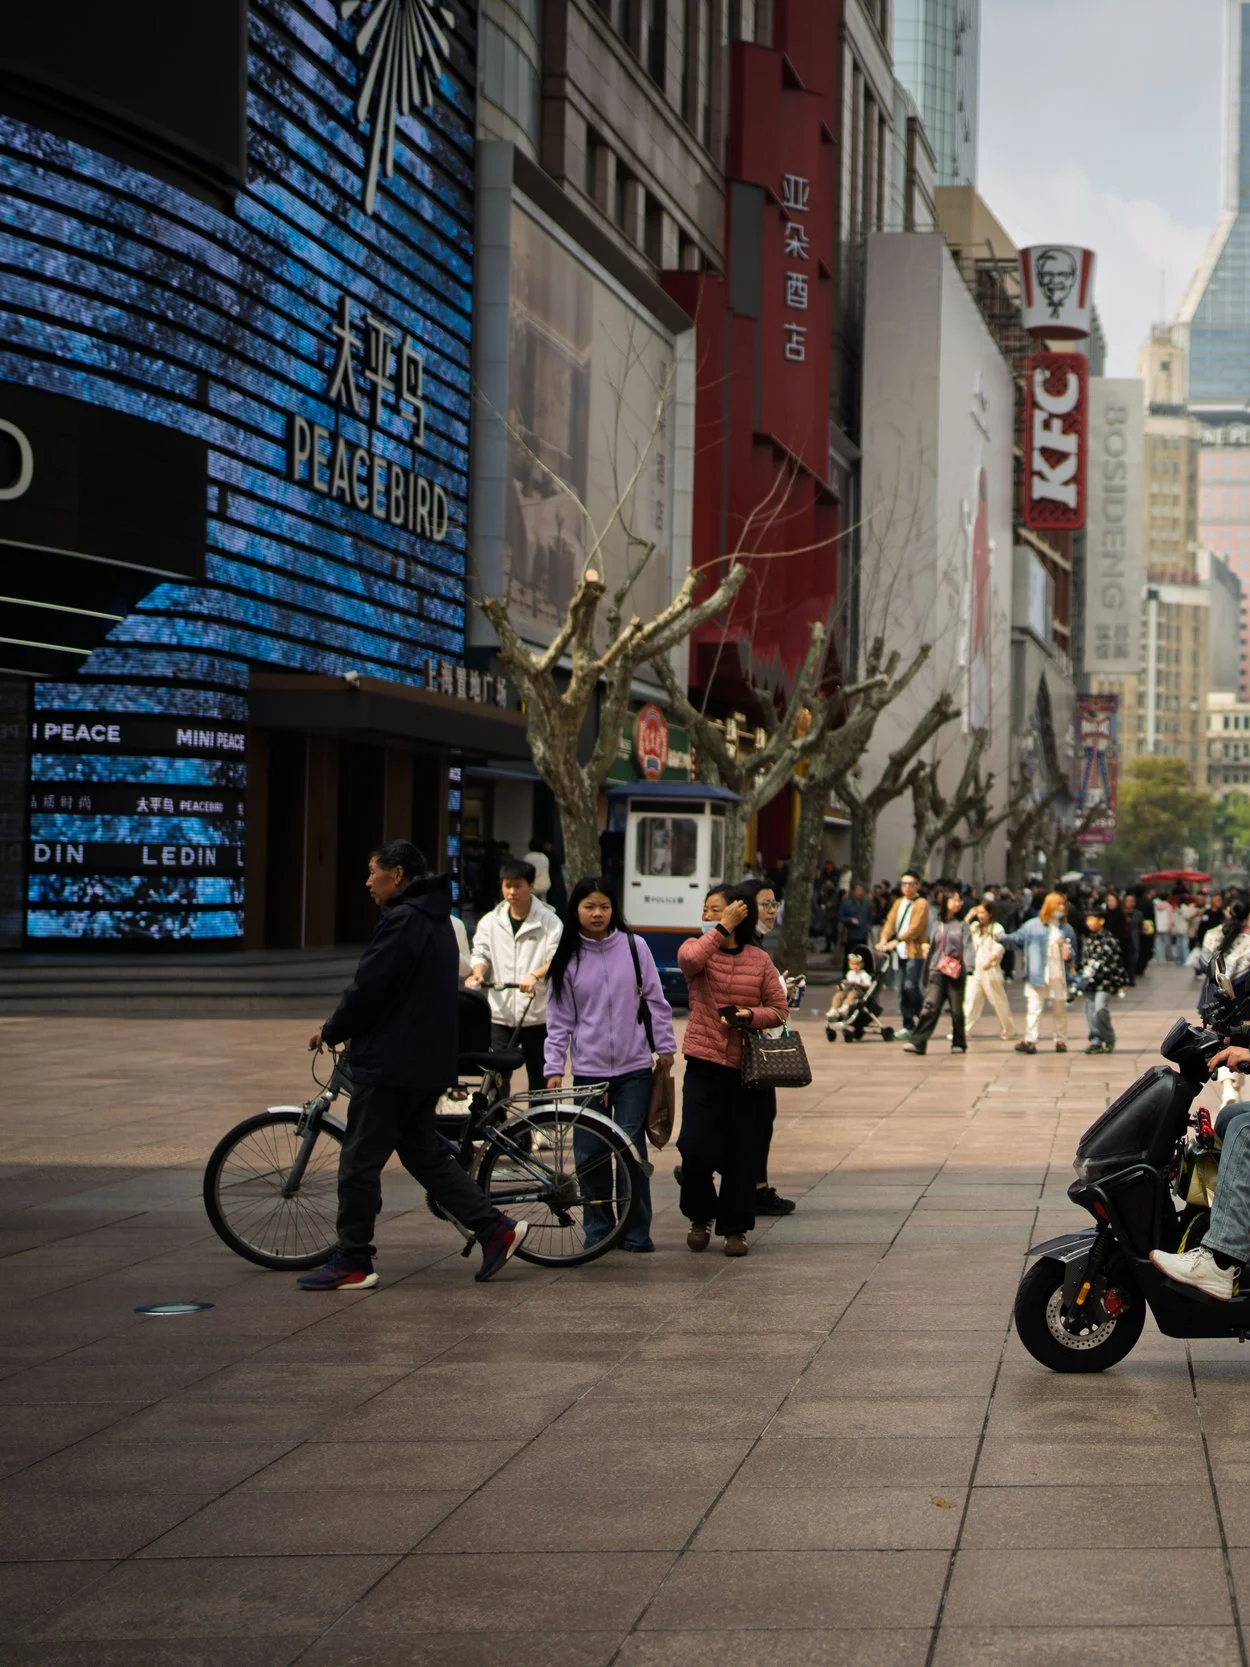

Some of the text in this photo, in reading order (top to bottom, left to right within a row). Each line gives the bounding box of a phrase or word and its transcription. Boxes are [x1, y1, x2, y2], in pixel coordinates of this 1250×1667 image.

[328, 296, 425, 447] 太平鸟
[1031, 367, 1080, 510] KFC
[292, 415, 449, 542] PEACEBIRD
[1102, 403, 1128, 609] BOSIDENG
[44, 723, 121, 743] PEACE
[176, 728, 245, 750] MINI PEACE
[137, 797, 174, 812] 太平鸟
[34, 844, 84, 863] DIN
[143, 846, 216, 866] LEDIN
